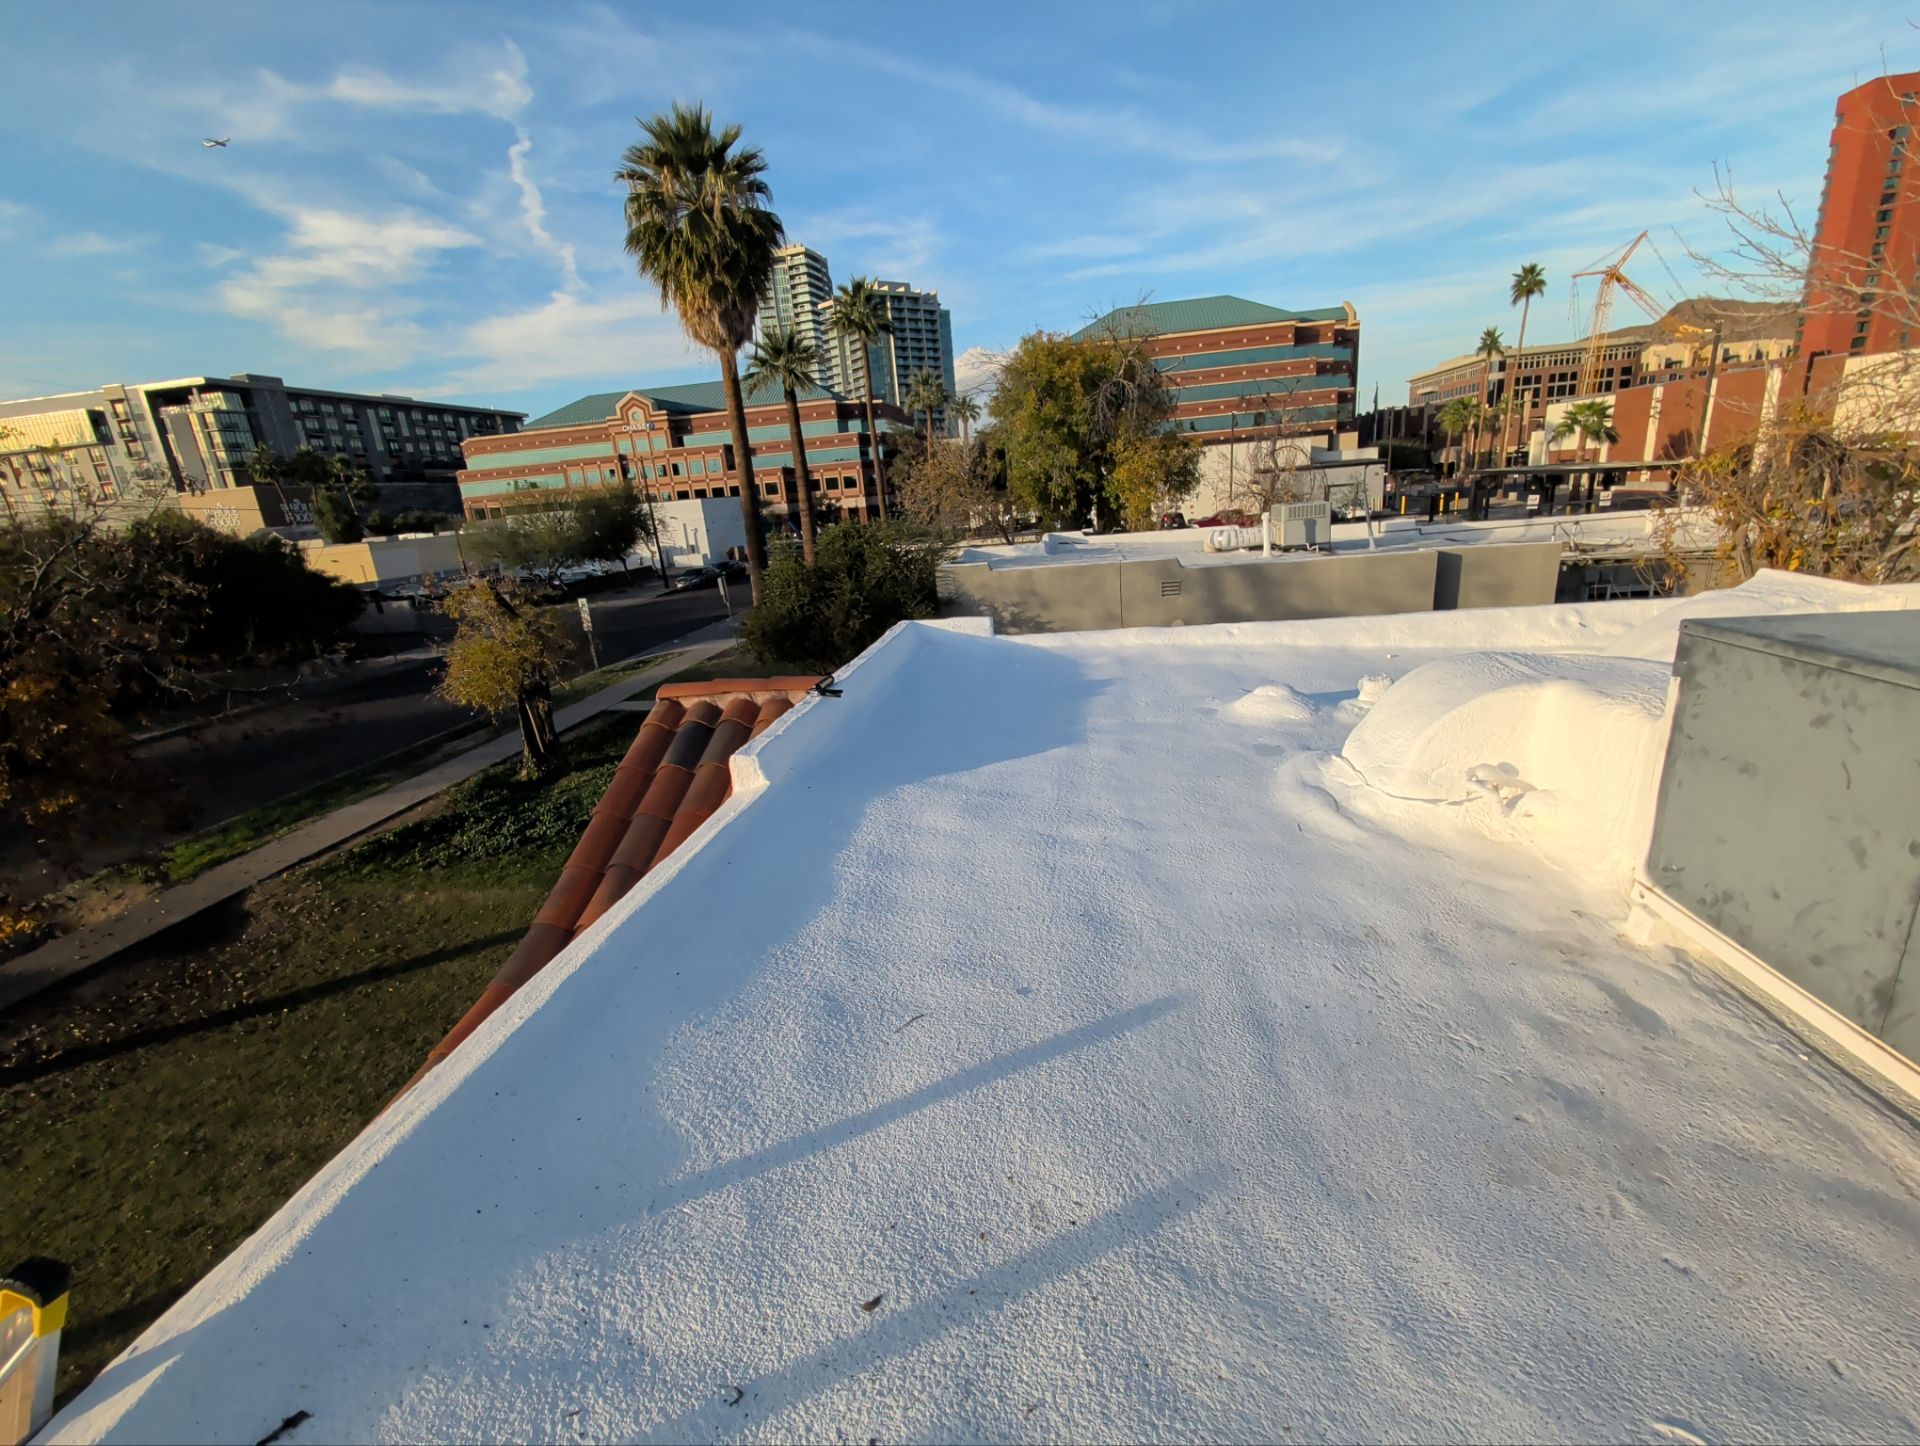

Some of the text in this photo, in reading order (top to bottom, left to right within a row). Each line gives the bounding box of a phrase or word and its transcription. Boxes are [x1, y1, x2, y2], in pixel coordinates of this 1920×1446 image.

[622, 424, 647, 432] CHASE
[203, 507, 239, 517] WHOLE
[209, 516, 241, 528] FOODS
[284, 512, 313, 523] FOOD
